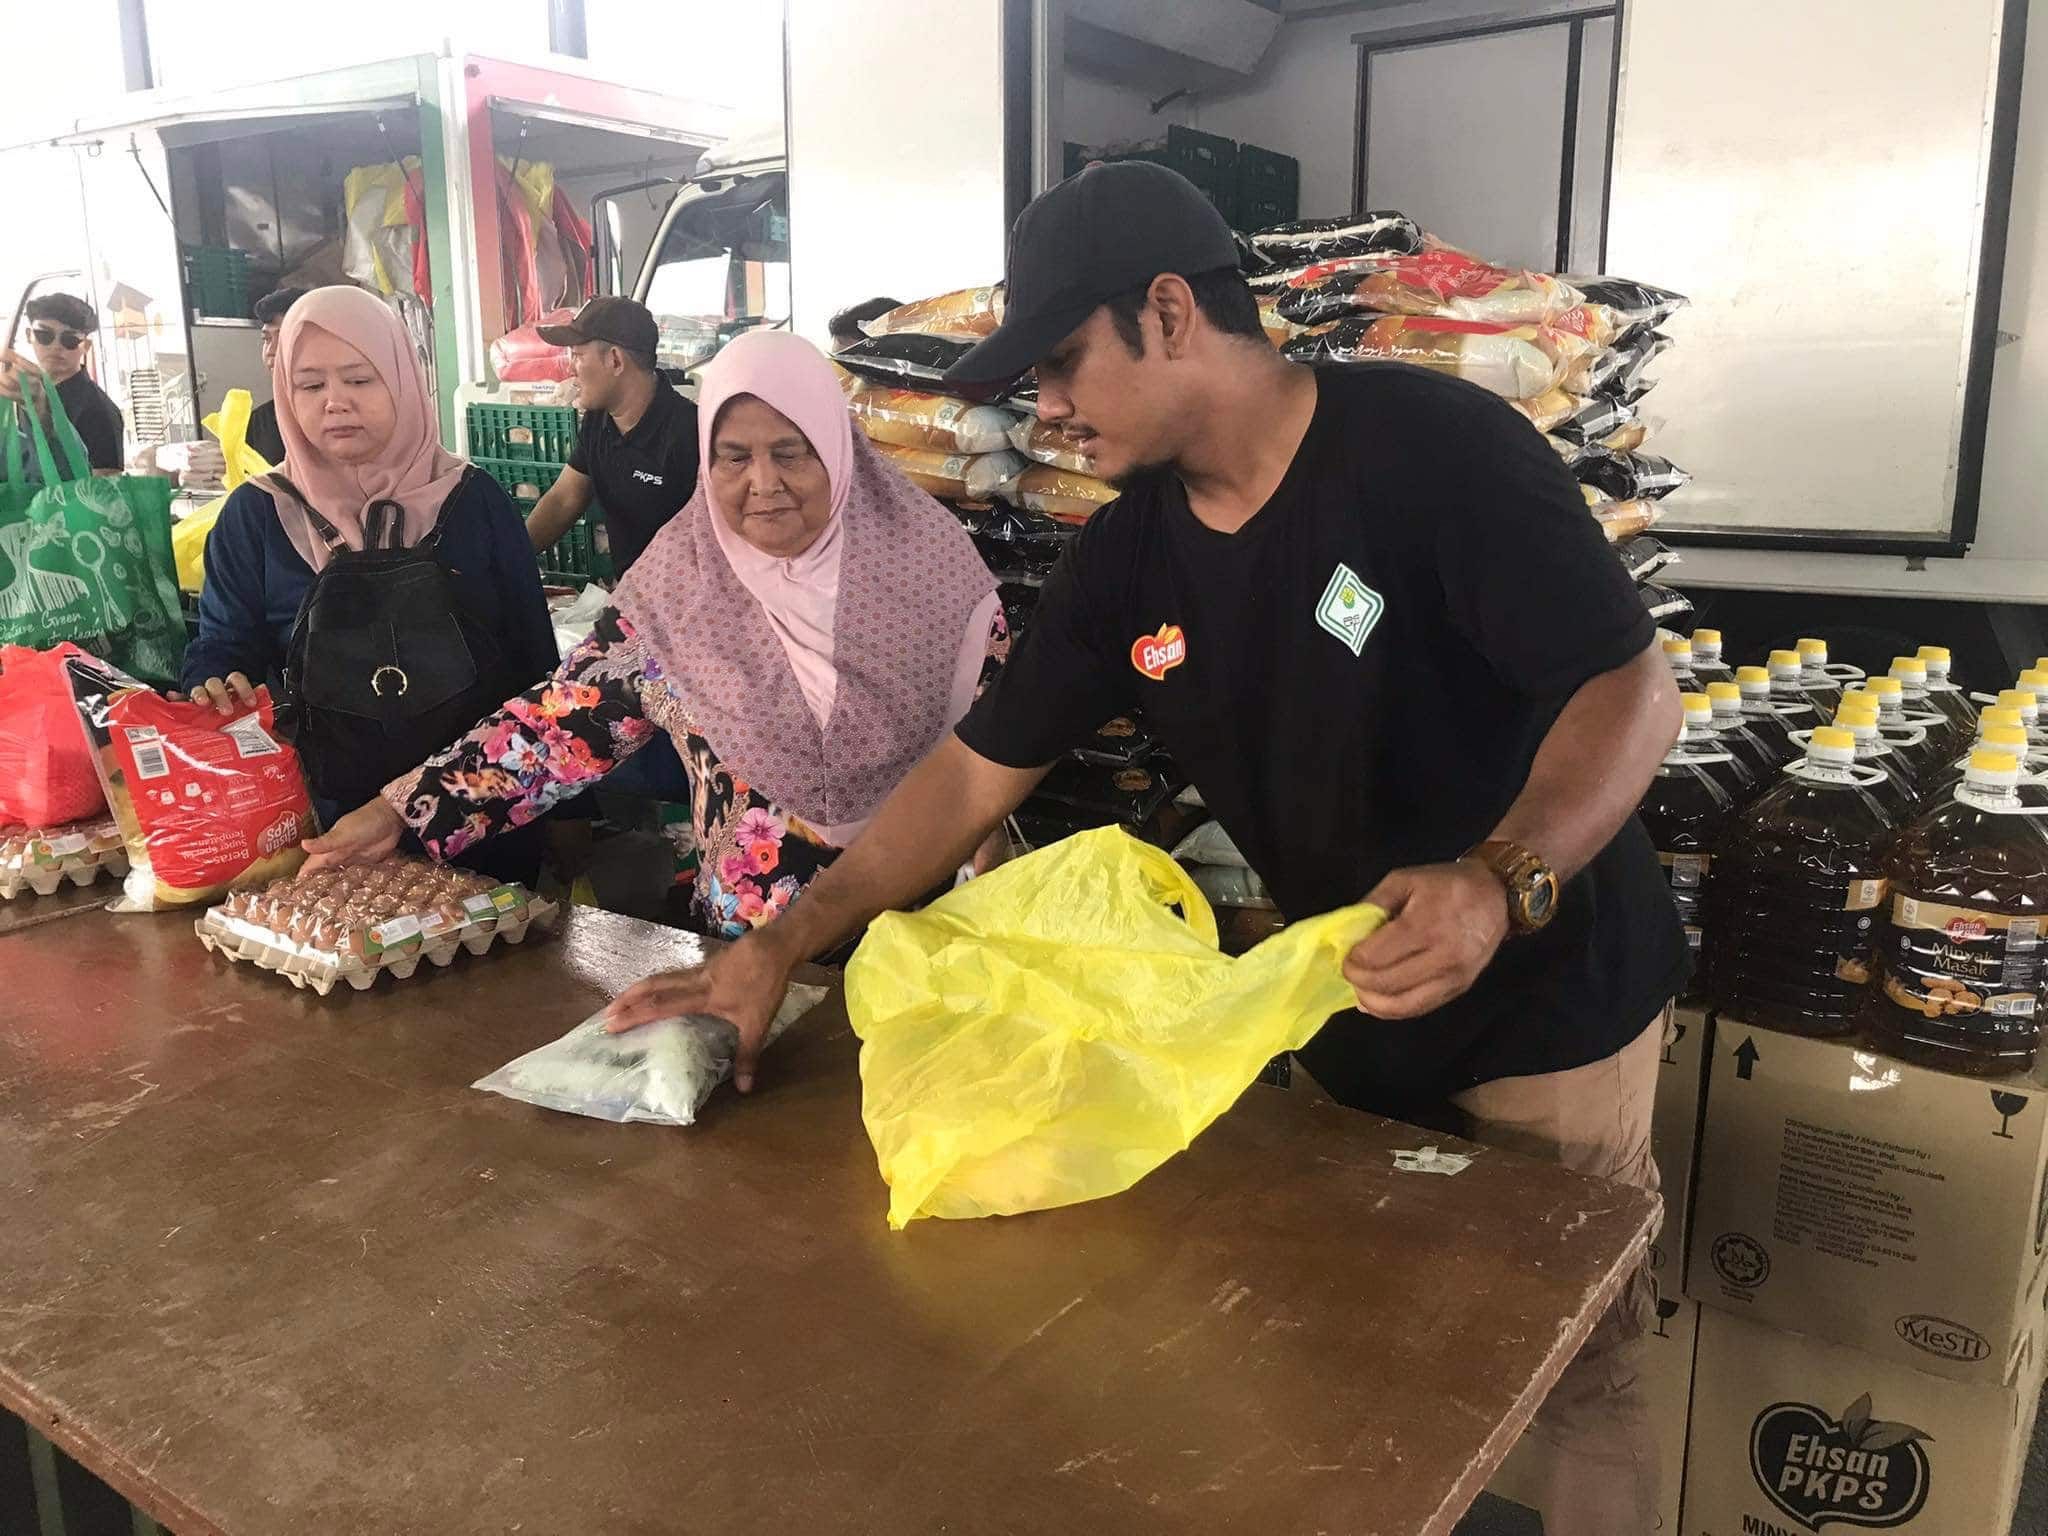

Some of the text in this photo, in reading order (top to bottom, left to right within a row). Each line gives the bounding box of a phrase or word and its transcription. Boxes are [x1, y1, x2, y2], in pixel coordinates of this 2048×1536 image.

[632, 470, 664, 486] PKPS
[1143, 638, 1183, 671] Ehsan
[219, 837, 248, 850] Super
[212, 848, 250, 865] Beras
[1932, 942, 1993, 963] Minyak
[1933, 955, 1990, 978] Masak
[1903, 1318, 1982, 1358] MeSTI
[1786, 1432, 1890, 1479] Ehsan
[1777, 1464, 1889, 1511] PKPS
